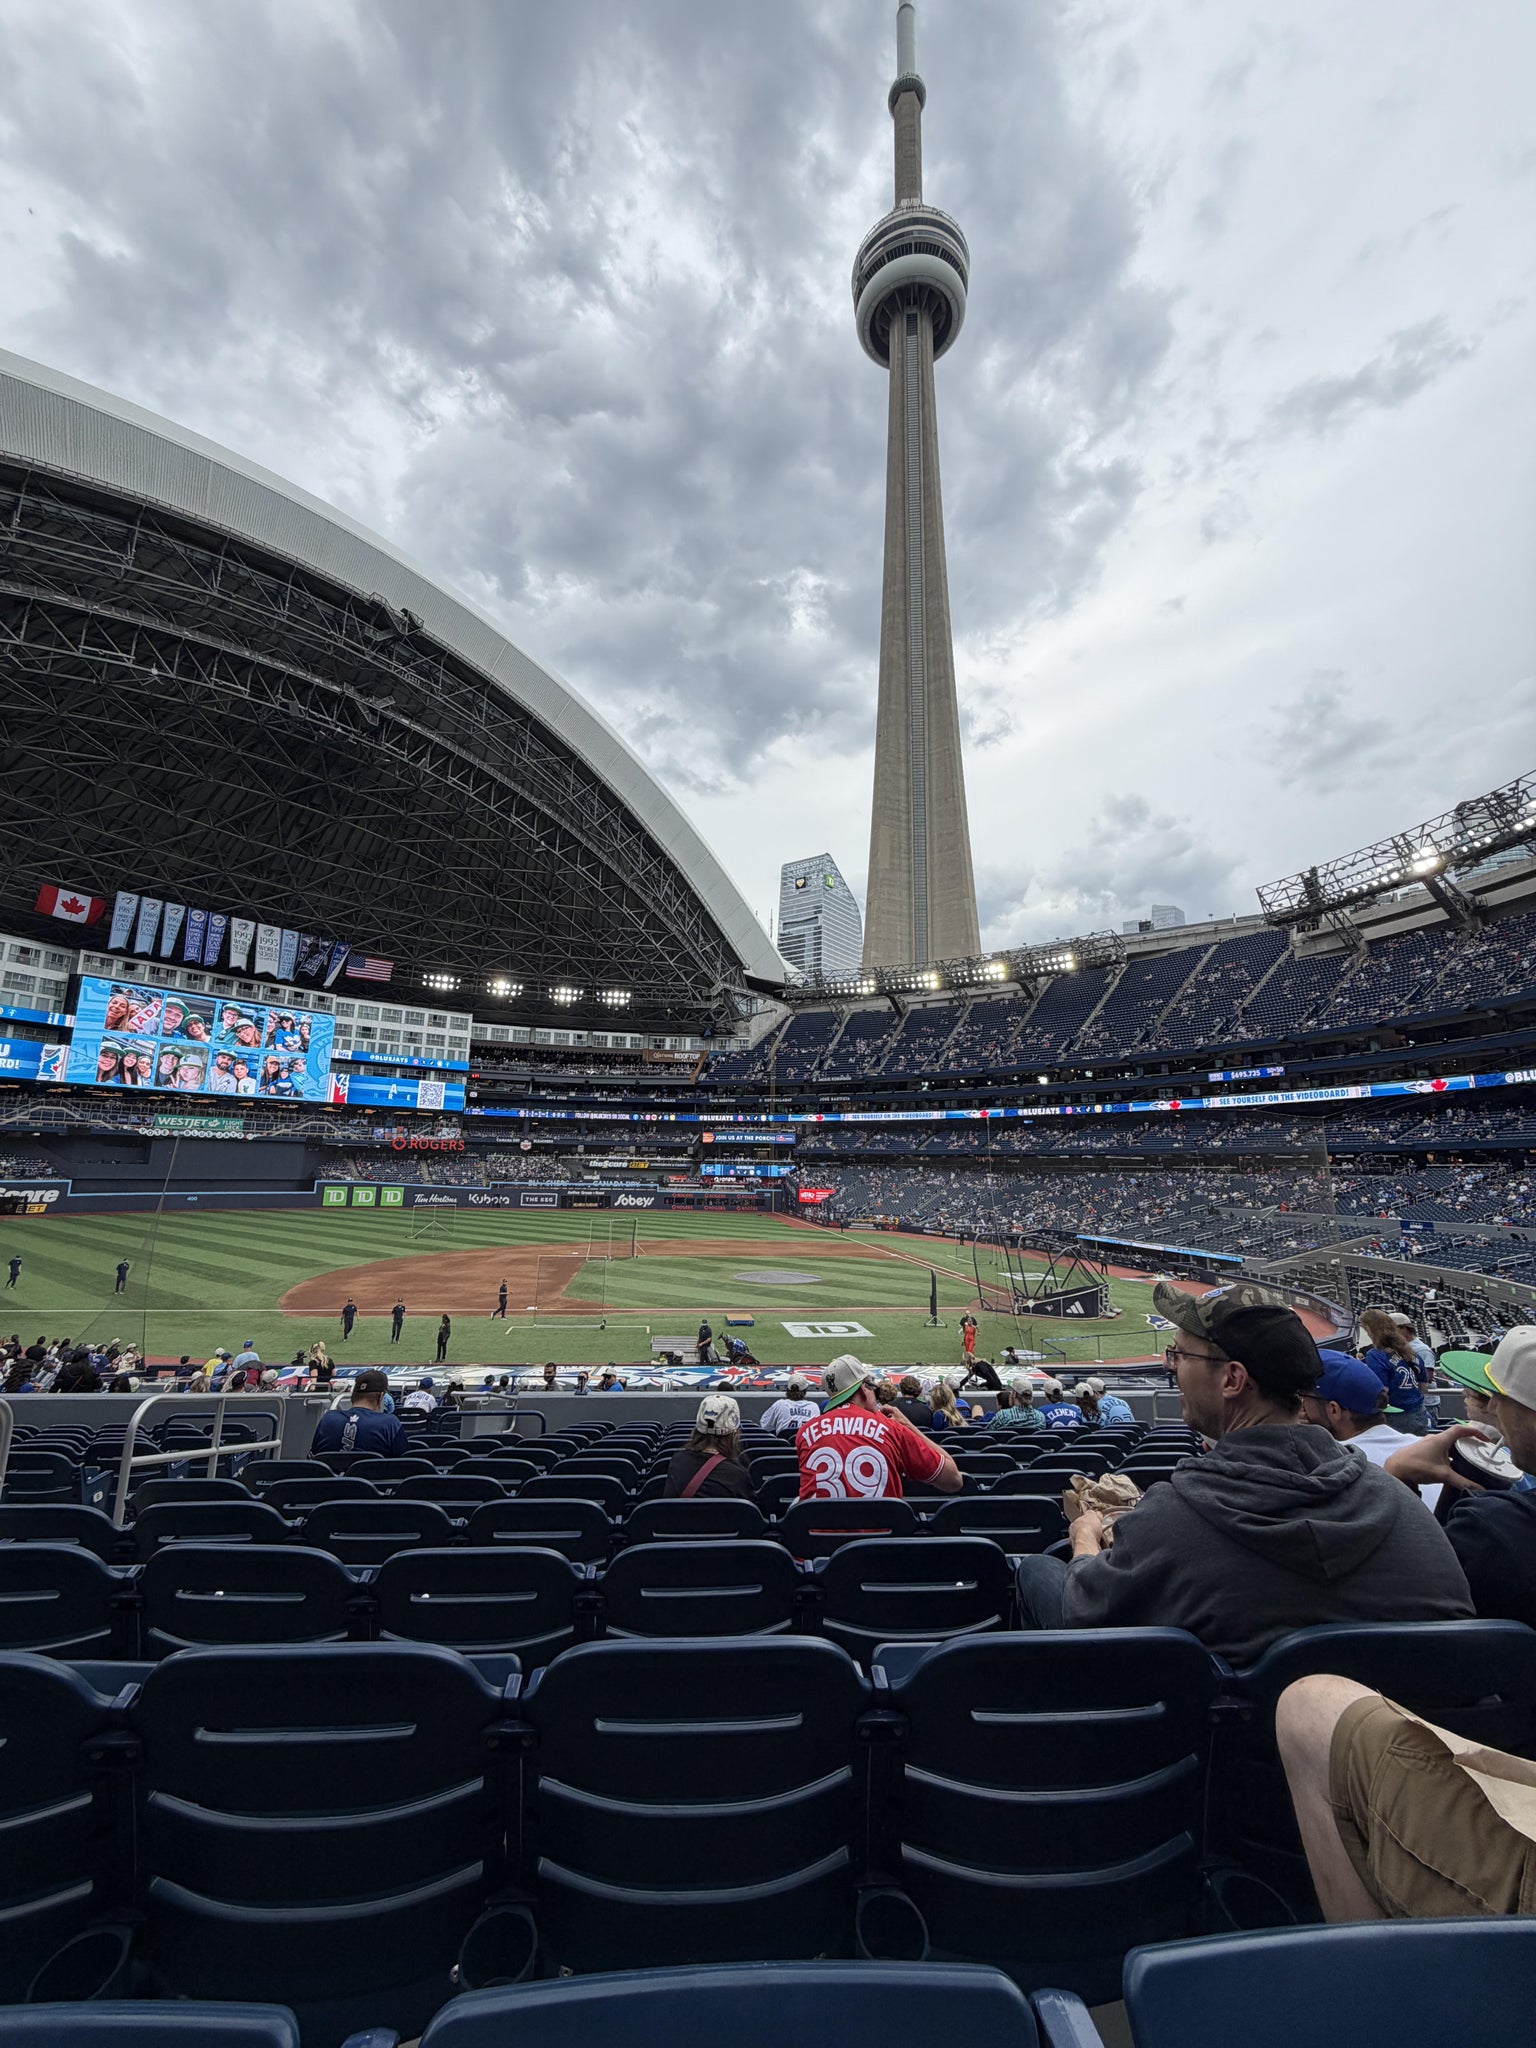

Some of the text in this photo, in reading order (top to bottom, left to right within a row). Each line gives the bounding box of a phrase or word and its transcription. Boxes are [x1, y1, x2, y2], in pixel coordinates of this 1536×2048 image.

[259, 937, 279, 947] 1993
[369, 1054, 409, 1064] @BLUEJAYS
[1232, 1096, 1266, 1105] YOURSELF
[1281, 1093, 1294, 1101] THE
[1295, 1089, 1350, 1100] VIDEOBOARD!
[1017, 1106, 1060, 1116] @BLUEJAYS
[157, 1116, 209, 1128] WESTJET
[408, 1138, 465, 1151] ROGERS
[589, 1160, 628, 1168] theScore
[326, 1190, 345, 1202] TD
[355, 1190, 374, 1202] TD
[383, 1190, 401, 1202] TD
[414, 1194, 458, 1203] Tim Hortons
[468, 1193, 510, 1205] Kubota
[614, 1193, 655, 1208] Sobeys
[789, 1407, 812, 1417] BARGER
[1046, 1407, 1077, 1421] CLEMENT
[801, 1416, 890, 1448] YESAVAGE
[805, 1445, 889, 1499] 39
